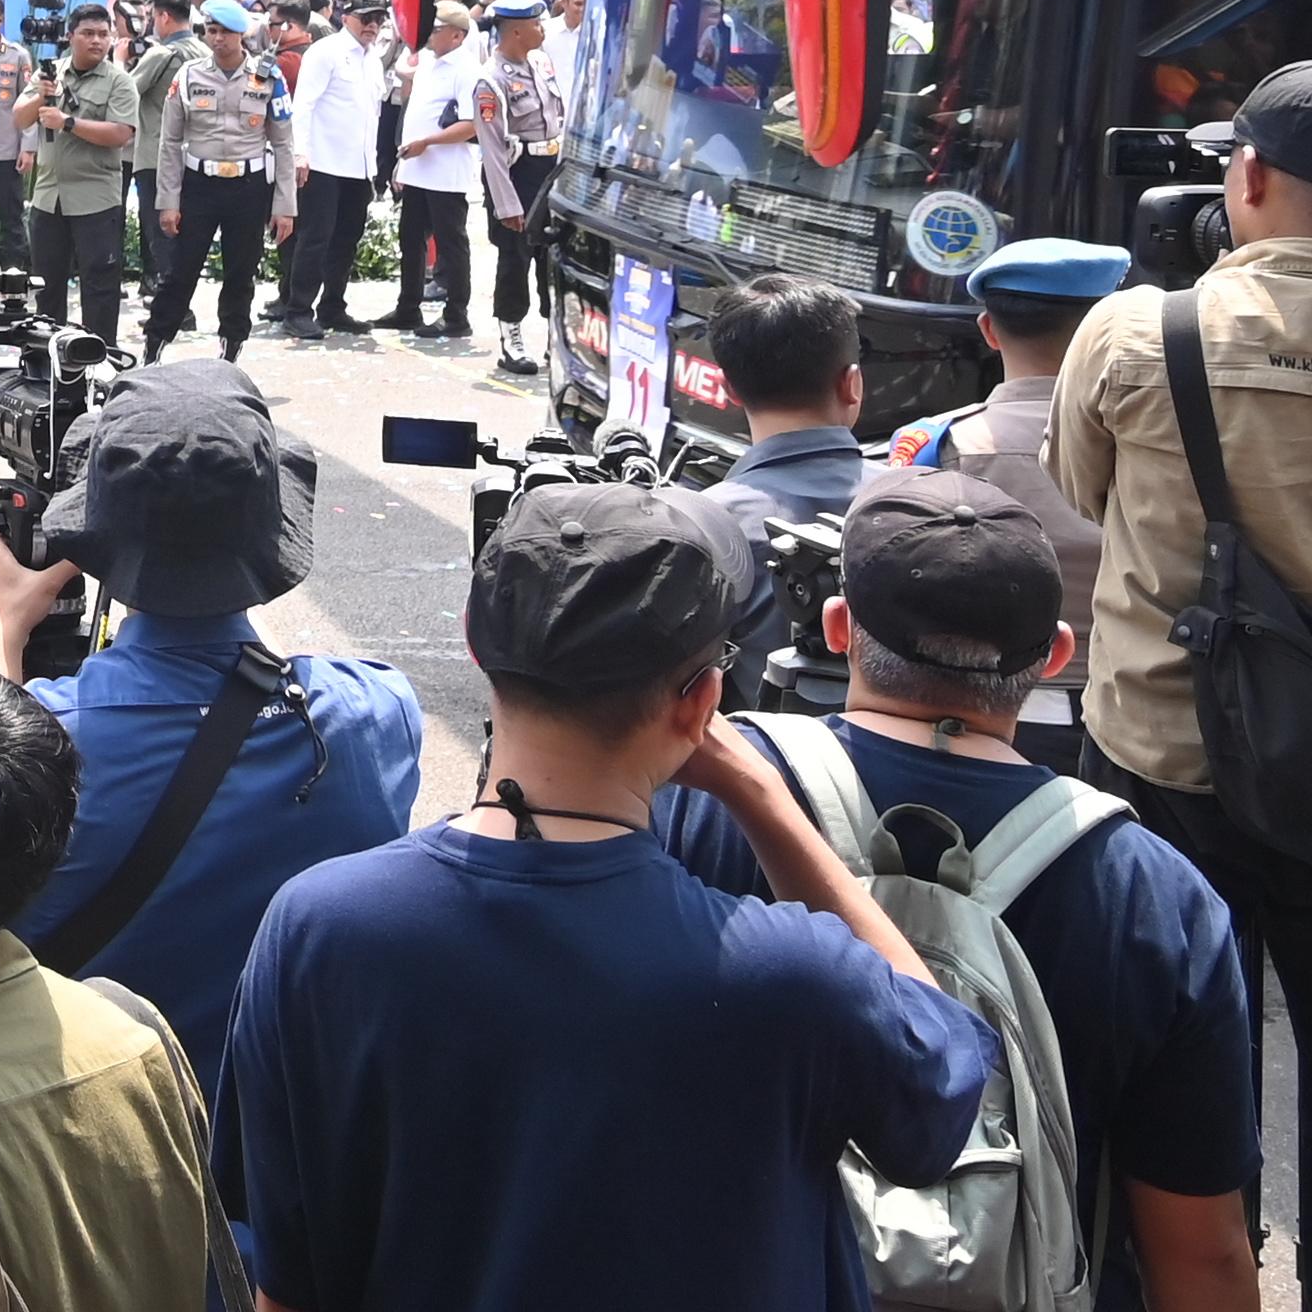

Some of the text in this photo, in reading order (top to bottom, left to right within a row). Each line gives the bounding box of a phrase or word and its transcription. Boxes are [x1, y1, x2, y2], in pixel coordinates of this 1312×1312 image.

[192, 88, 270, 99] ARGO POLRI
[626, 361, 651, 427] 11
